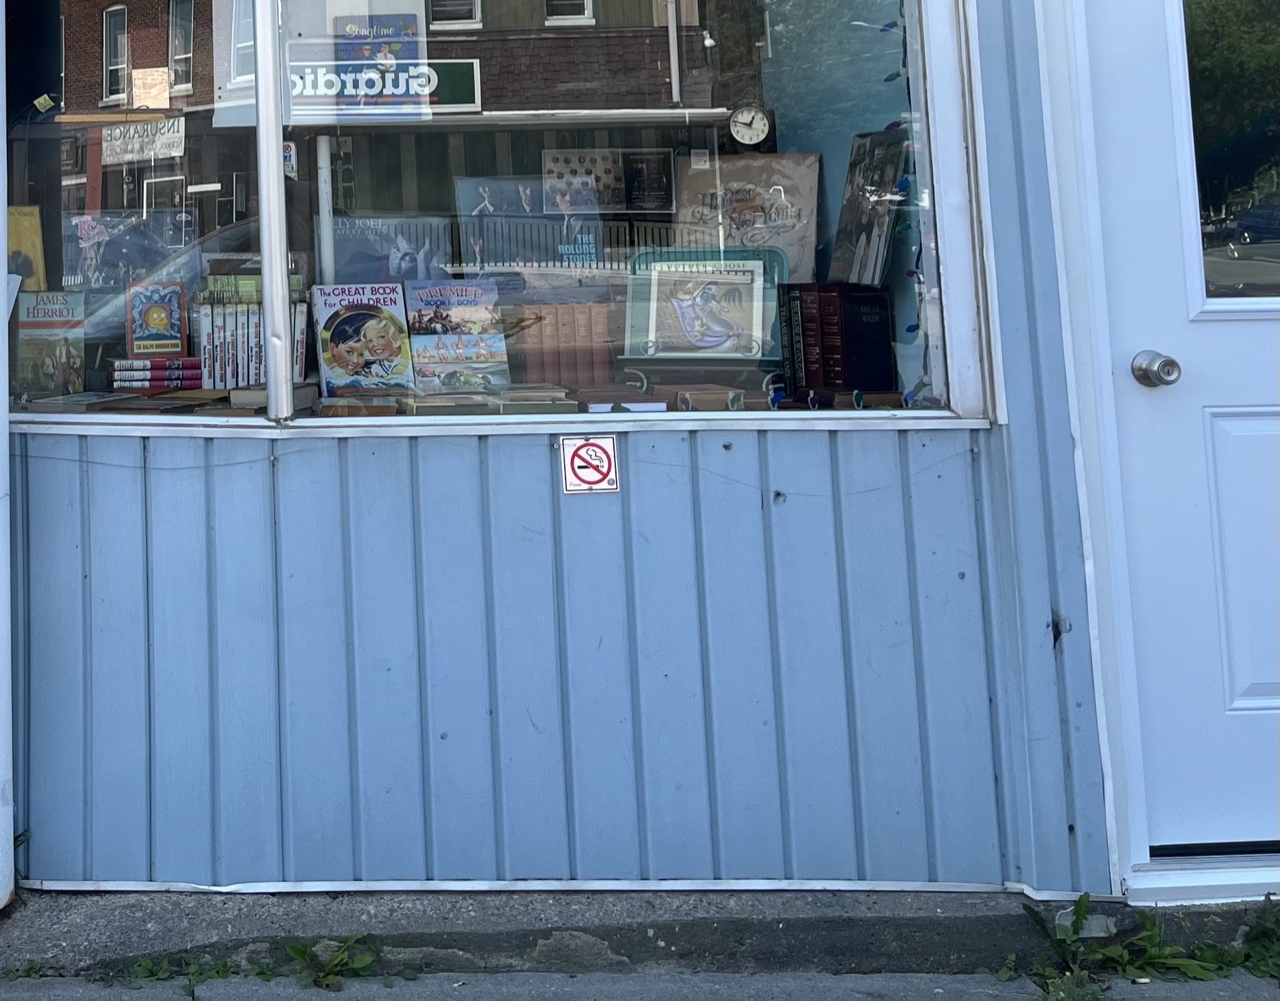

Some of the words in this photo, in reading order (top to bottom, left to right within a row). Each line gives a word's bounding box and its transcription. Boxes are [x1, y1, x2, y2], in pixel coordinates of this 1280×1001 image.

[345, 24, 395, 40] Songtime
[576, 234, 594, 244] THE
[558, 244, 595, 254] ROLLING
[563, 254, 597, 265] STONES
[317, 288, 332, 297] The
[332, 287, 367, 297] GREAT
[371, 286, 399, 296] BOOK
[34, 294, 69, 307] JAMES
[323, 299, 337, 308] for
[339, 297, 397, 307] CHILDREN
[424, 298, 447, 306] BOOK
[457, 298, 479, 306] BOYS
[26, 307, 77, 318] HERRIOT
[780, 306, 788, 346] TREASURE
[783, 348, 791, 376] ISLAND
